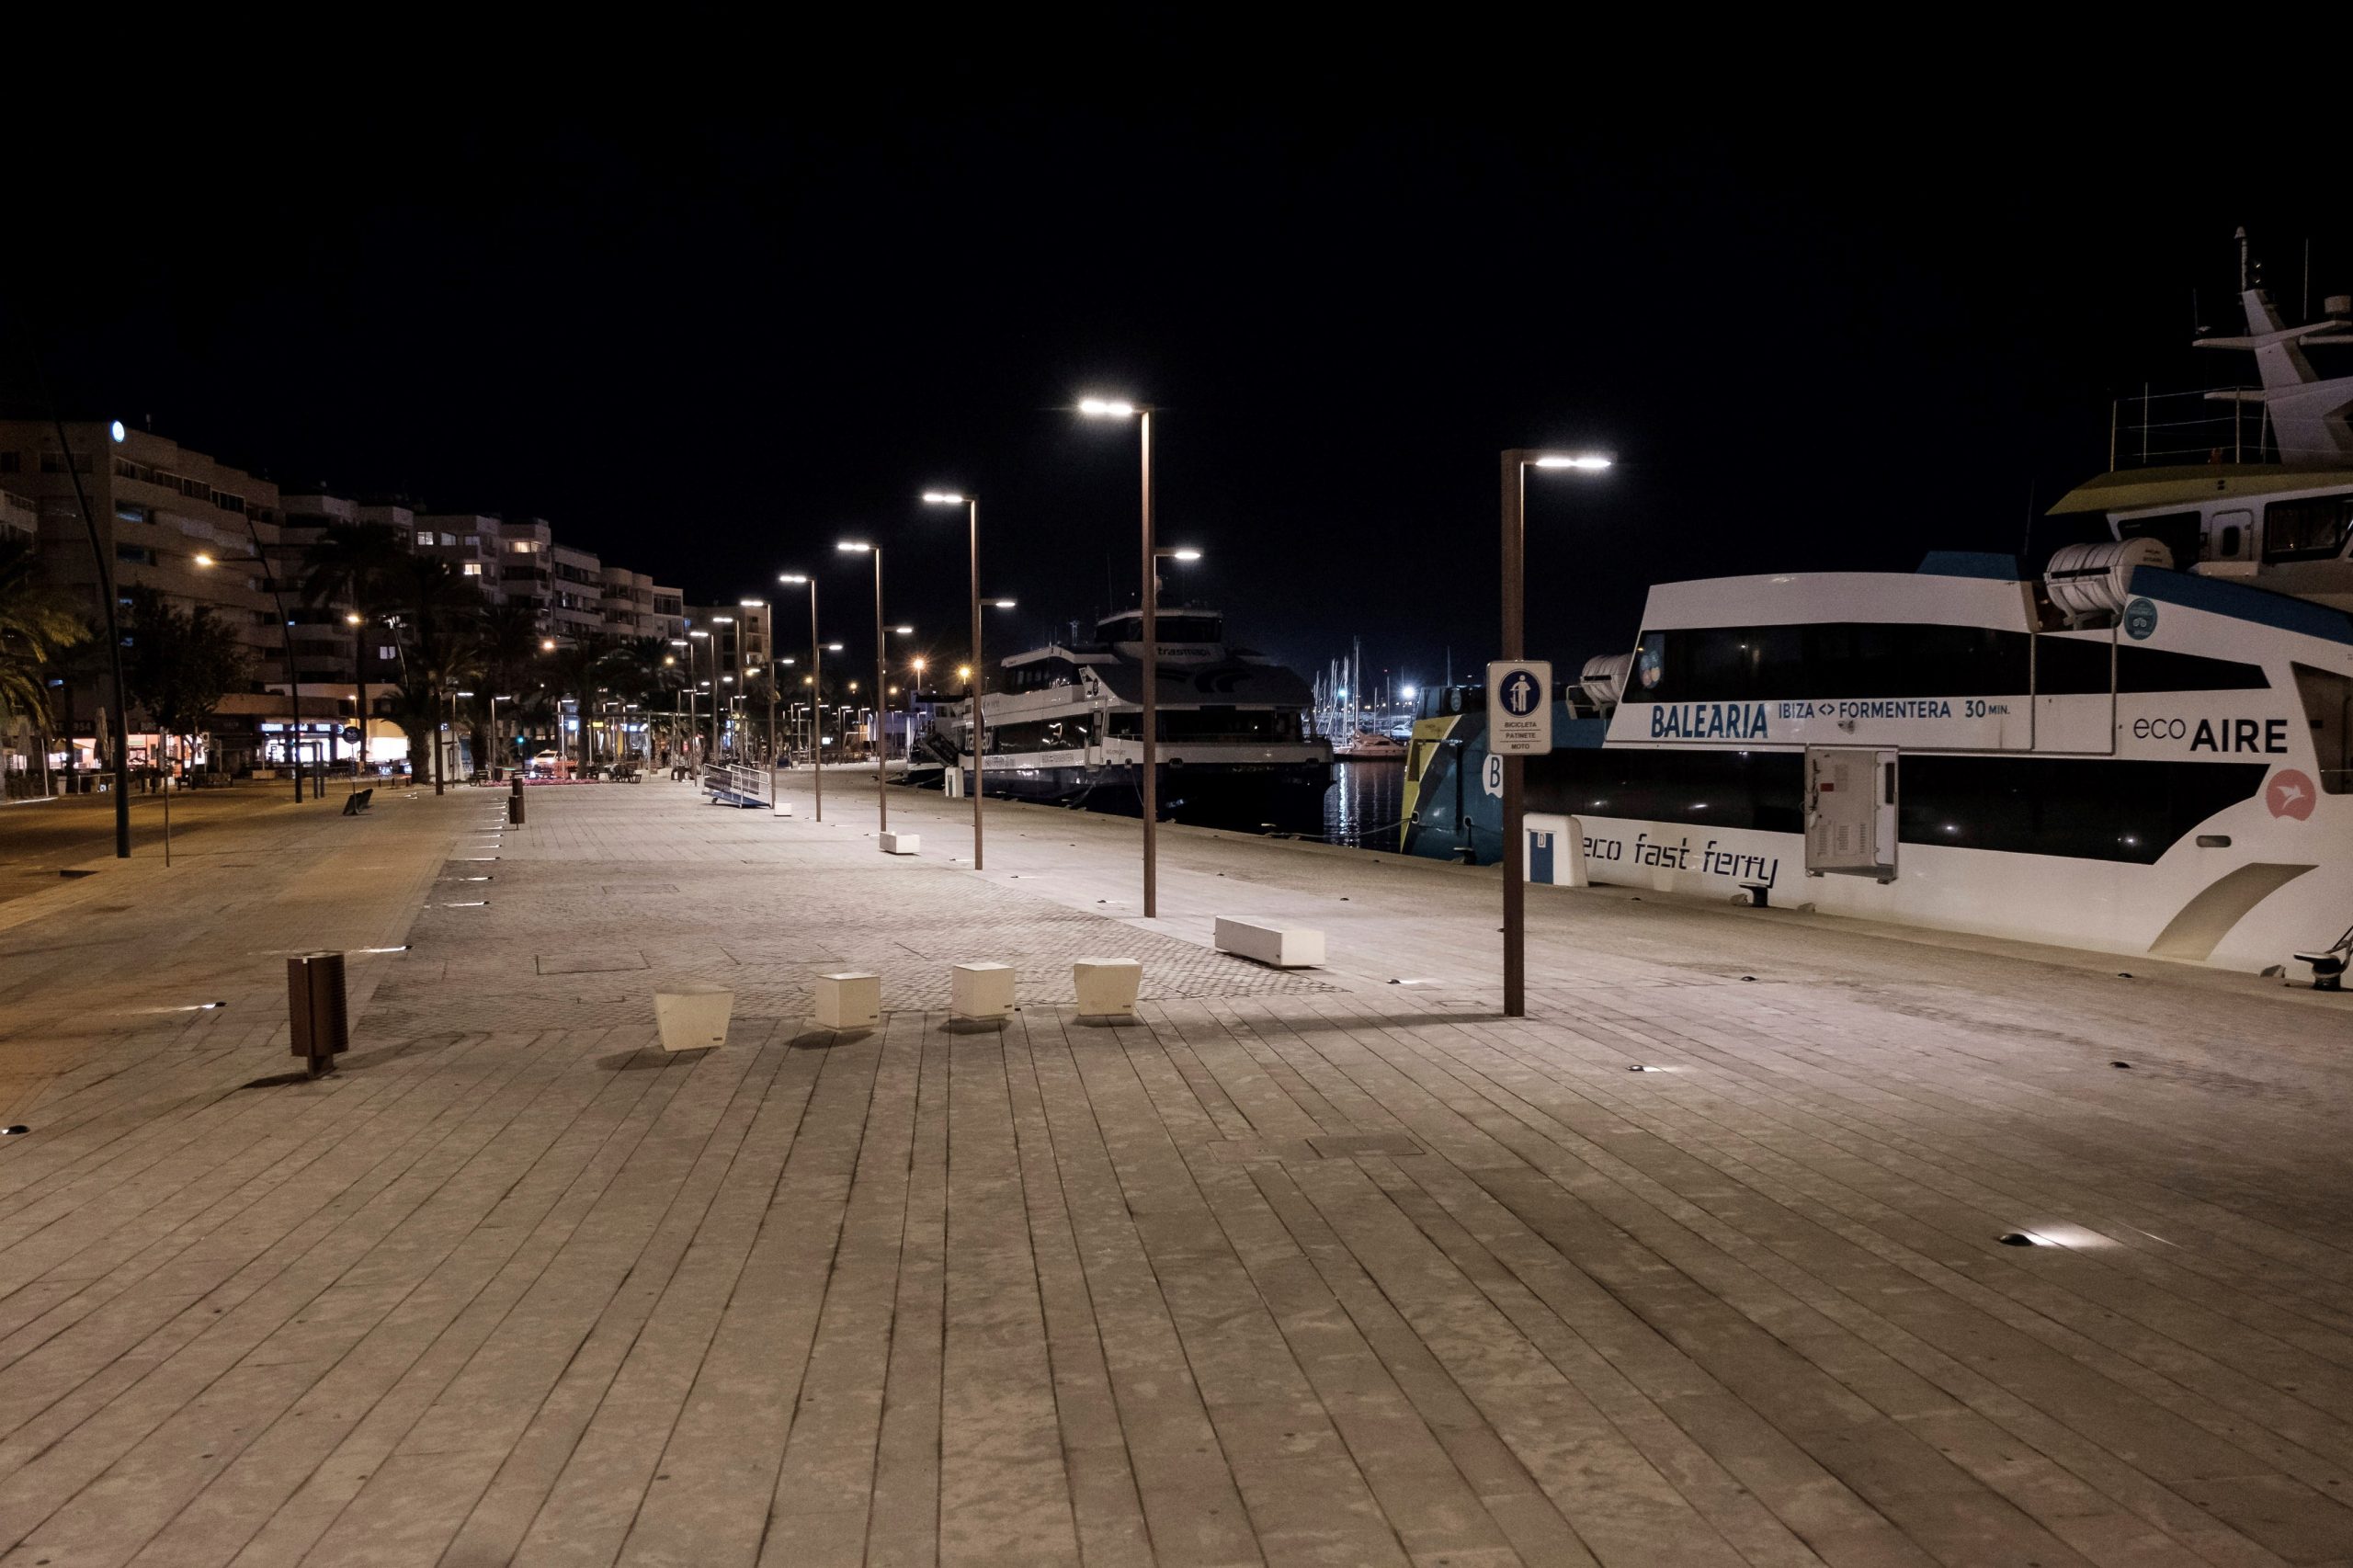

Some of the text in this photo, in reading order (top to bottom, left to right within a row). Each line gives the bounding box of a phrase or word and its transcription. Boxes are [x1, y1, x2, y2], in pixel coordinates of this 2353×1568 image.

[1779, 703, 1815, 719] IBIZA
[1839, 700, 1952, 719] FORMENTERA
[1965, 699, 1986, 718] 30
[2133, 718, 2288, 754] eco AIRE
[1634, 833, 1690, 869] fast
[1702, 840, 1779, 889] ferry
